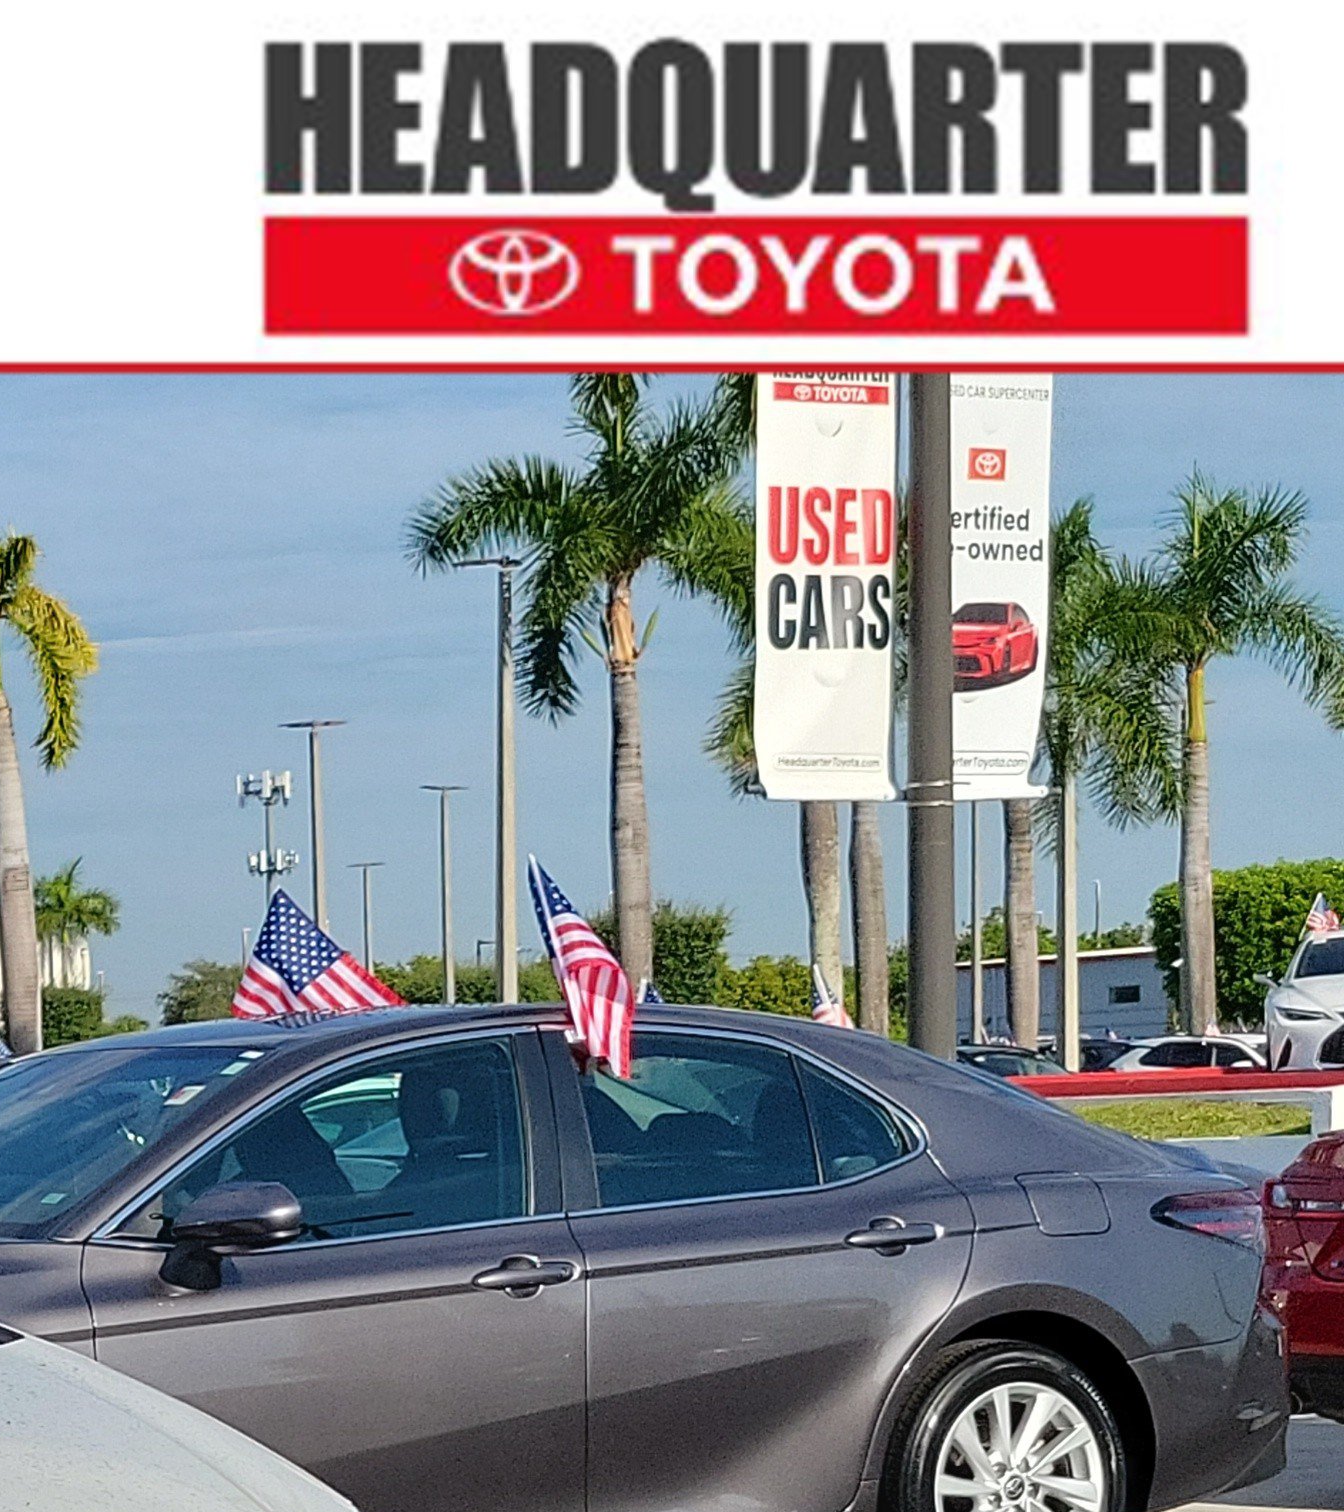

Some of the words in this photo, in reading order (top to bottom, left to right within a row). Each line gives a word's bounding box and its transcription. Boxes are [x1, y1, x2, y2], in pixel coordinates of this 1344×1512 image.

[813, 385, 868, 403] TOYOTA
[768, 486, 891, 566] USED
[950, 505, 1030, 531] ertified
[768, 573, 890, 651] CARS
